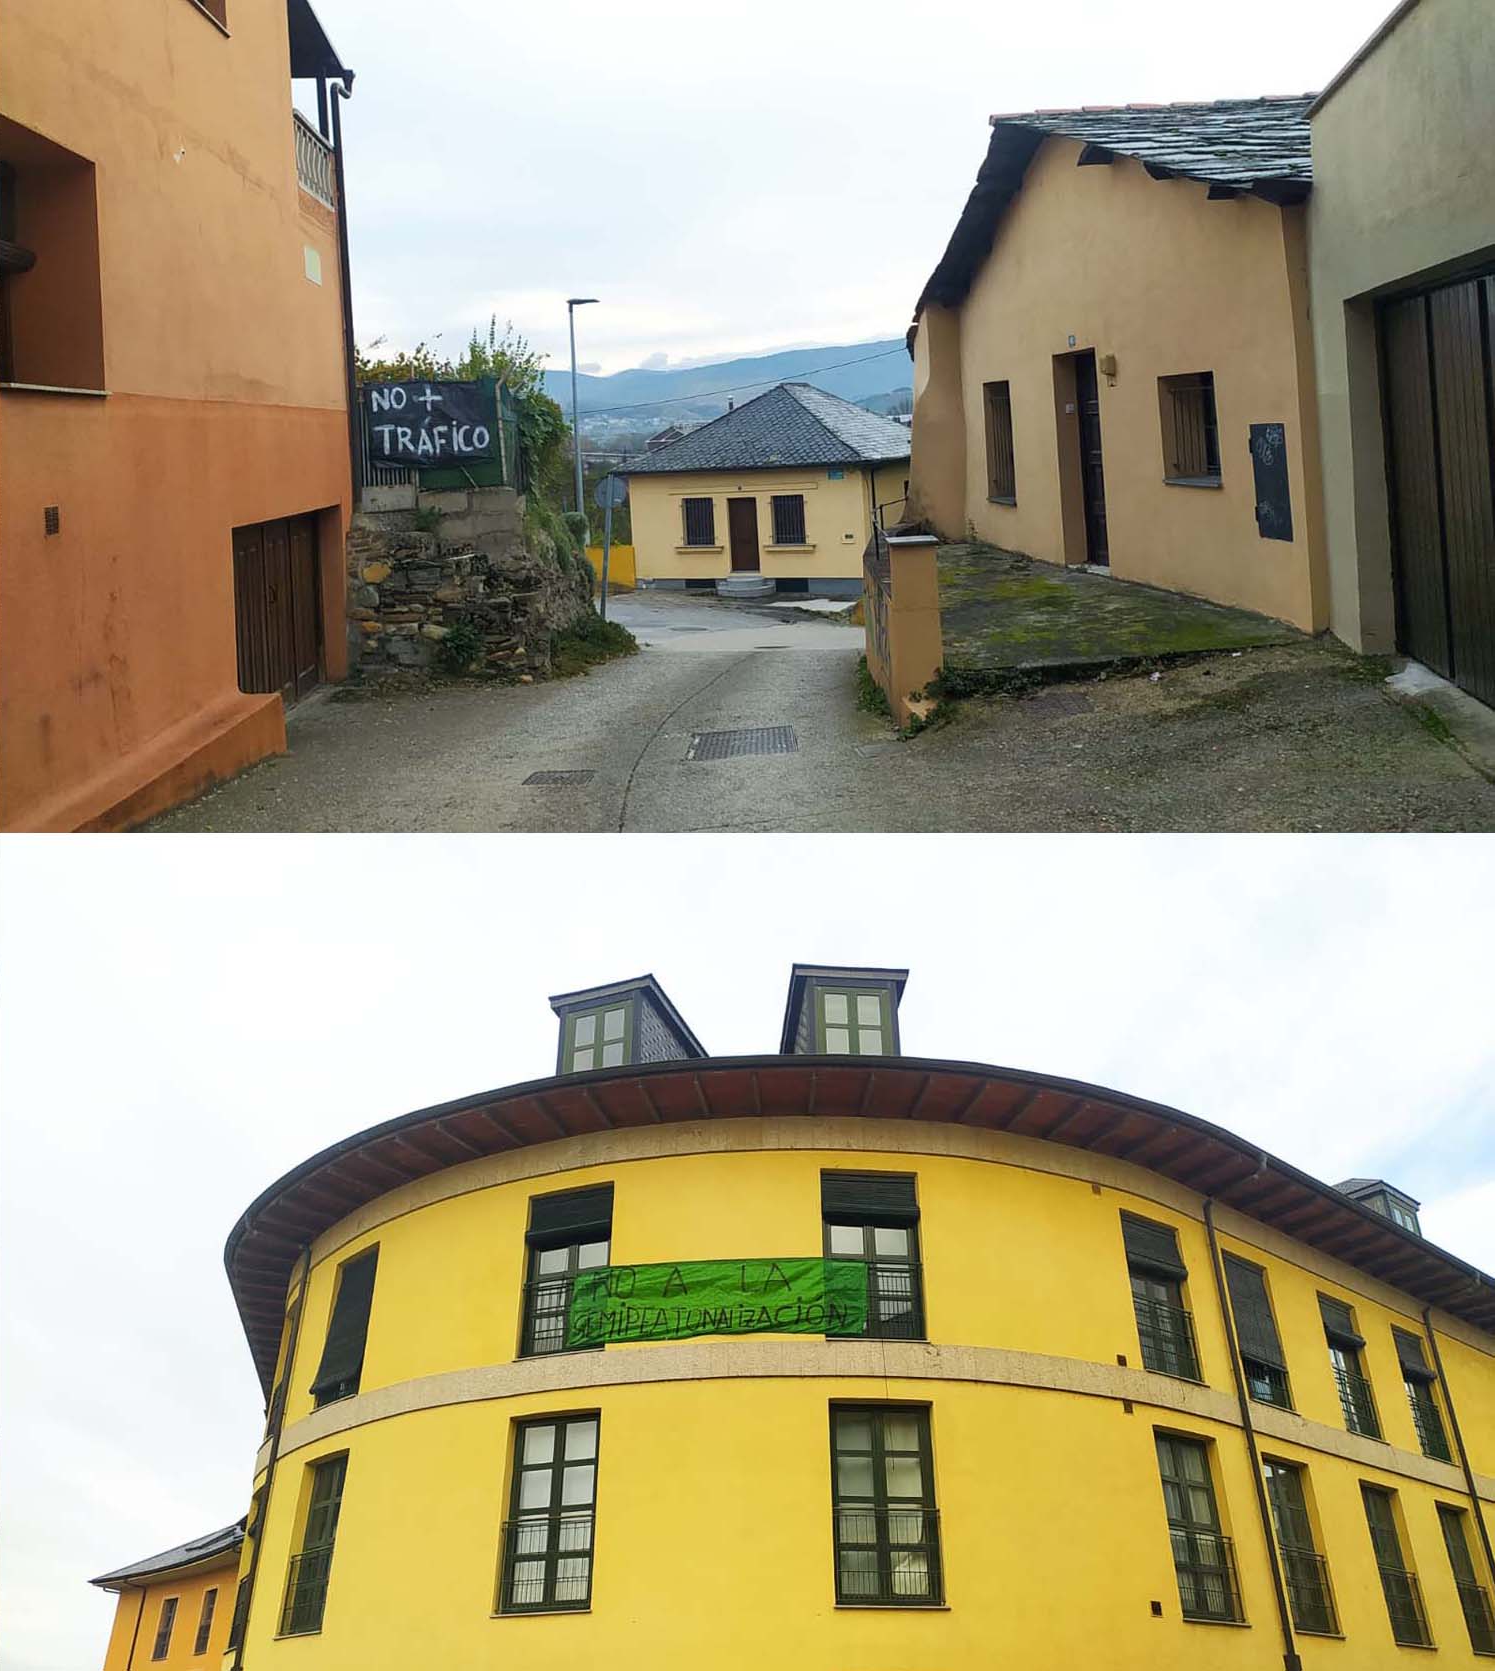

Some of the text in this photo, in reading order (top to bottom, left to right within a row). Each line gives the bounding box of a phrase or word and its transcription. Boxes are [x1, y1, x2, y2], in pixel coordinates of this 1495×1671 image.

[371, 386, 407, 412] NO
[591, 1262, 792, 1302] NO A LA
